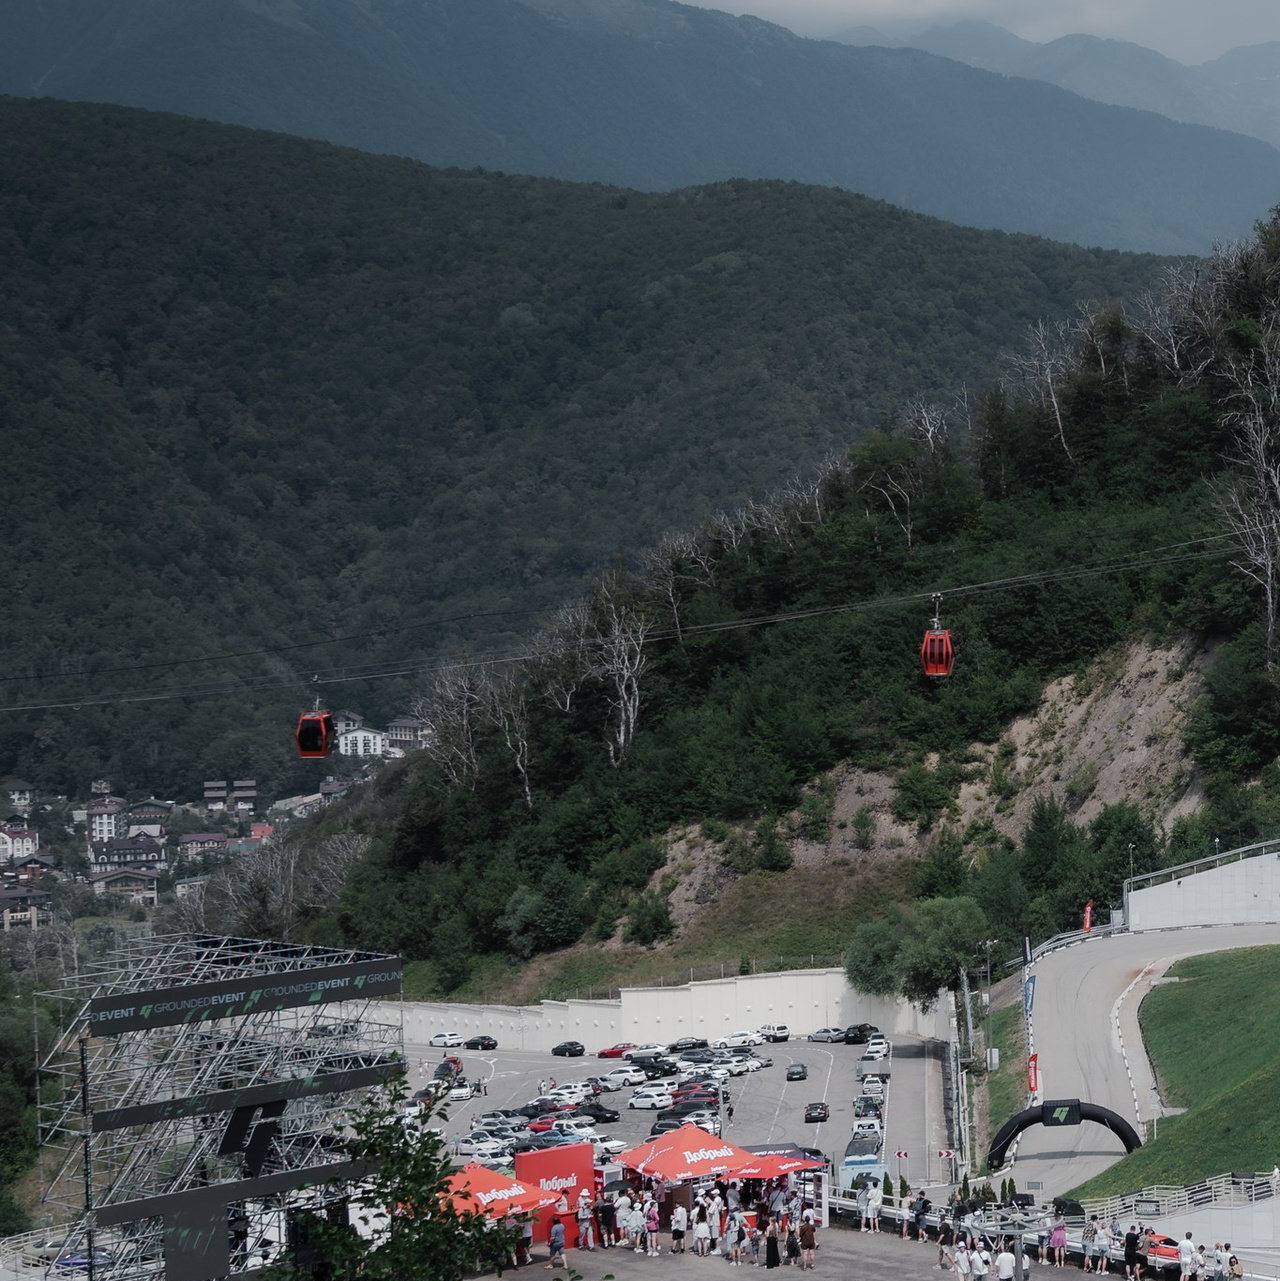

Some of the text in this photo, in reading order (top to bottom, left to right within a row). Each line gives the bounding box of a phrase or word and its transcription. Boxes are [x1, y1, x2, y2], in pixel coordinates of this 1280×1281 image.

[683, 1145, 735, 1164] Добрый
[539, 1173, 578, 1191] Добрый
[476, 1183, 526, 1205] Добрый
